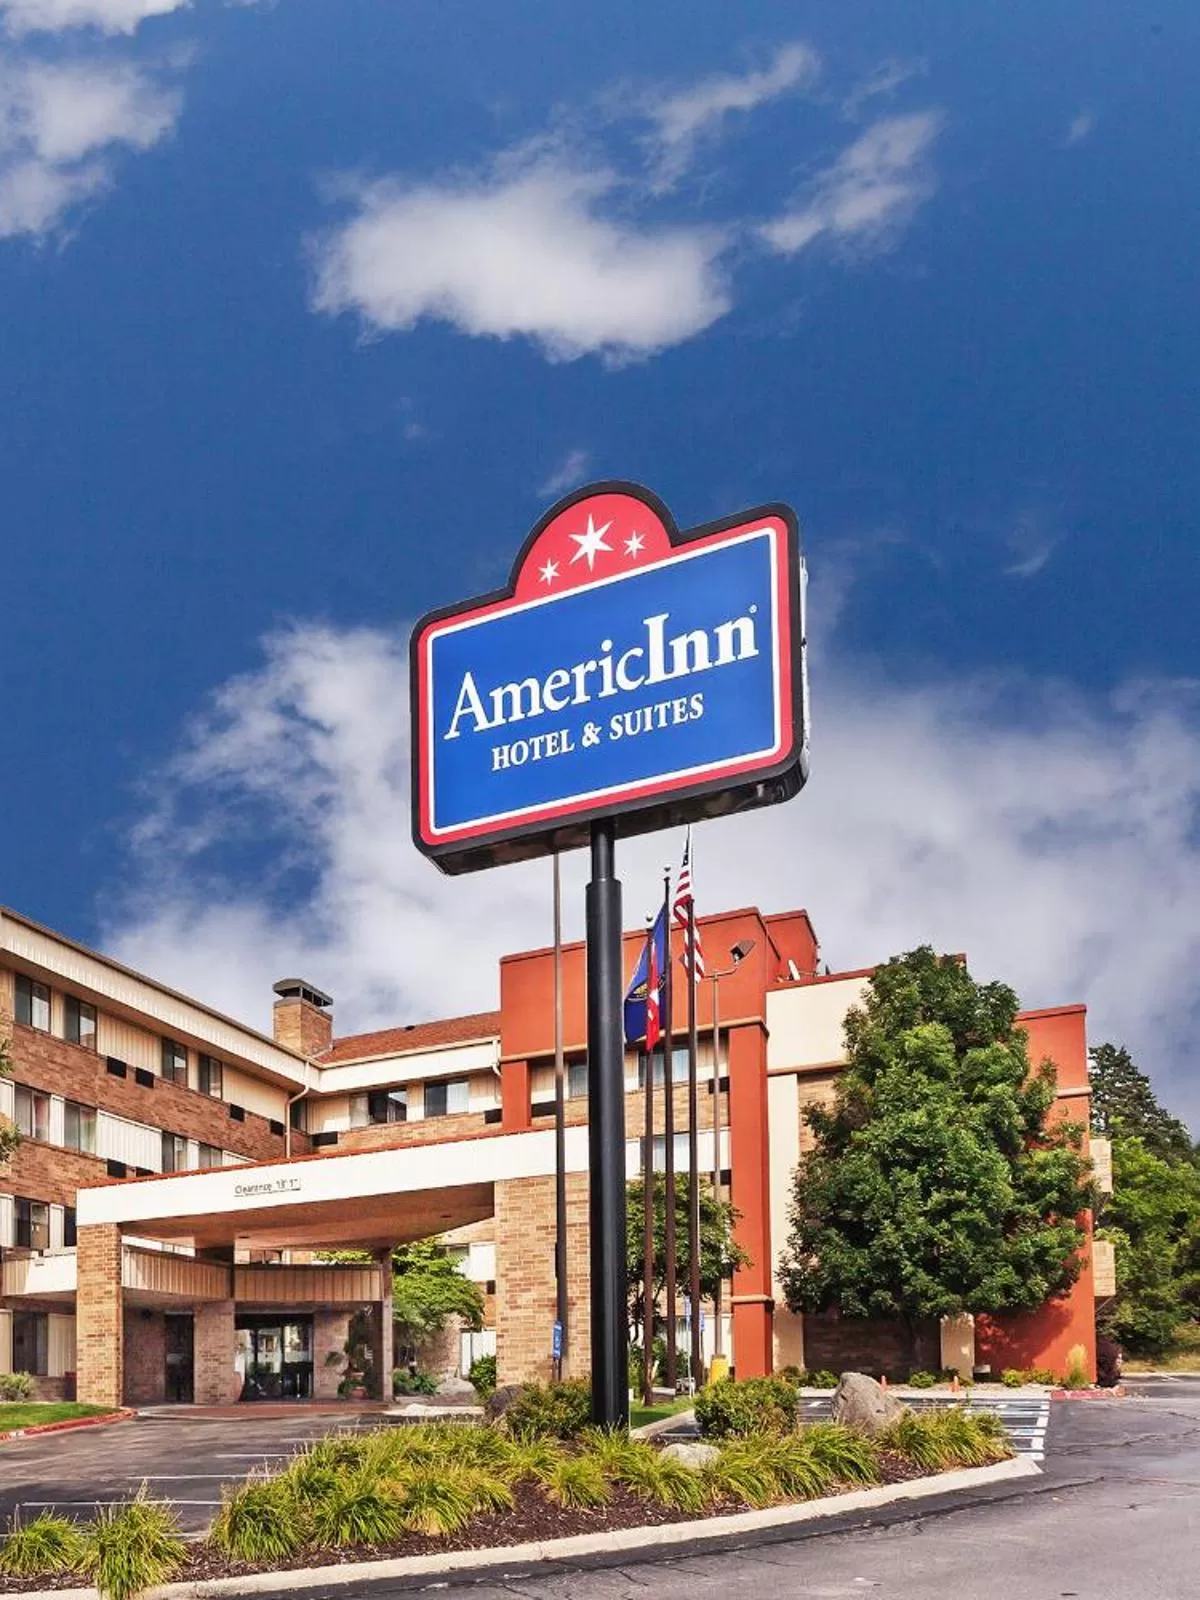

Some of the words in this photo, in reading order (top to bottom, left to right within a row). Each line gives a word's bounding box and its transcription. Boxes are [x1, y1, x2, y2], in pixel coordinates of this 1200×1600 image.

[443, 613, 760, 740] AmericInn
[491, 729, 575, 771] HOTEL
[581, 721, 602, 748] &
[609, 693, 704, 740] SUITES
